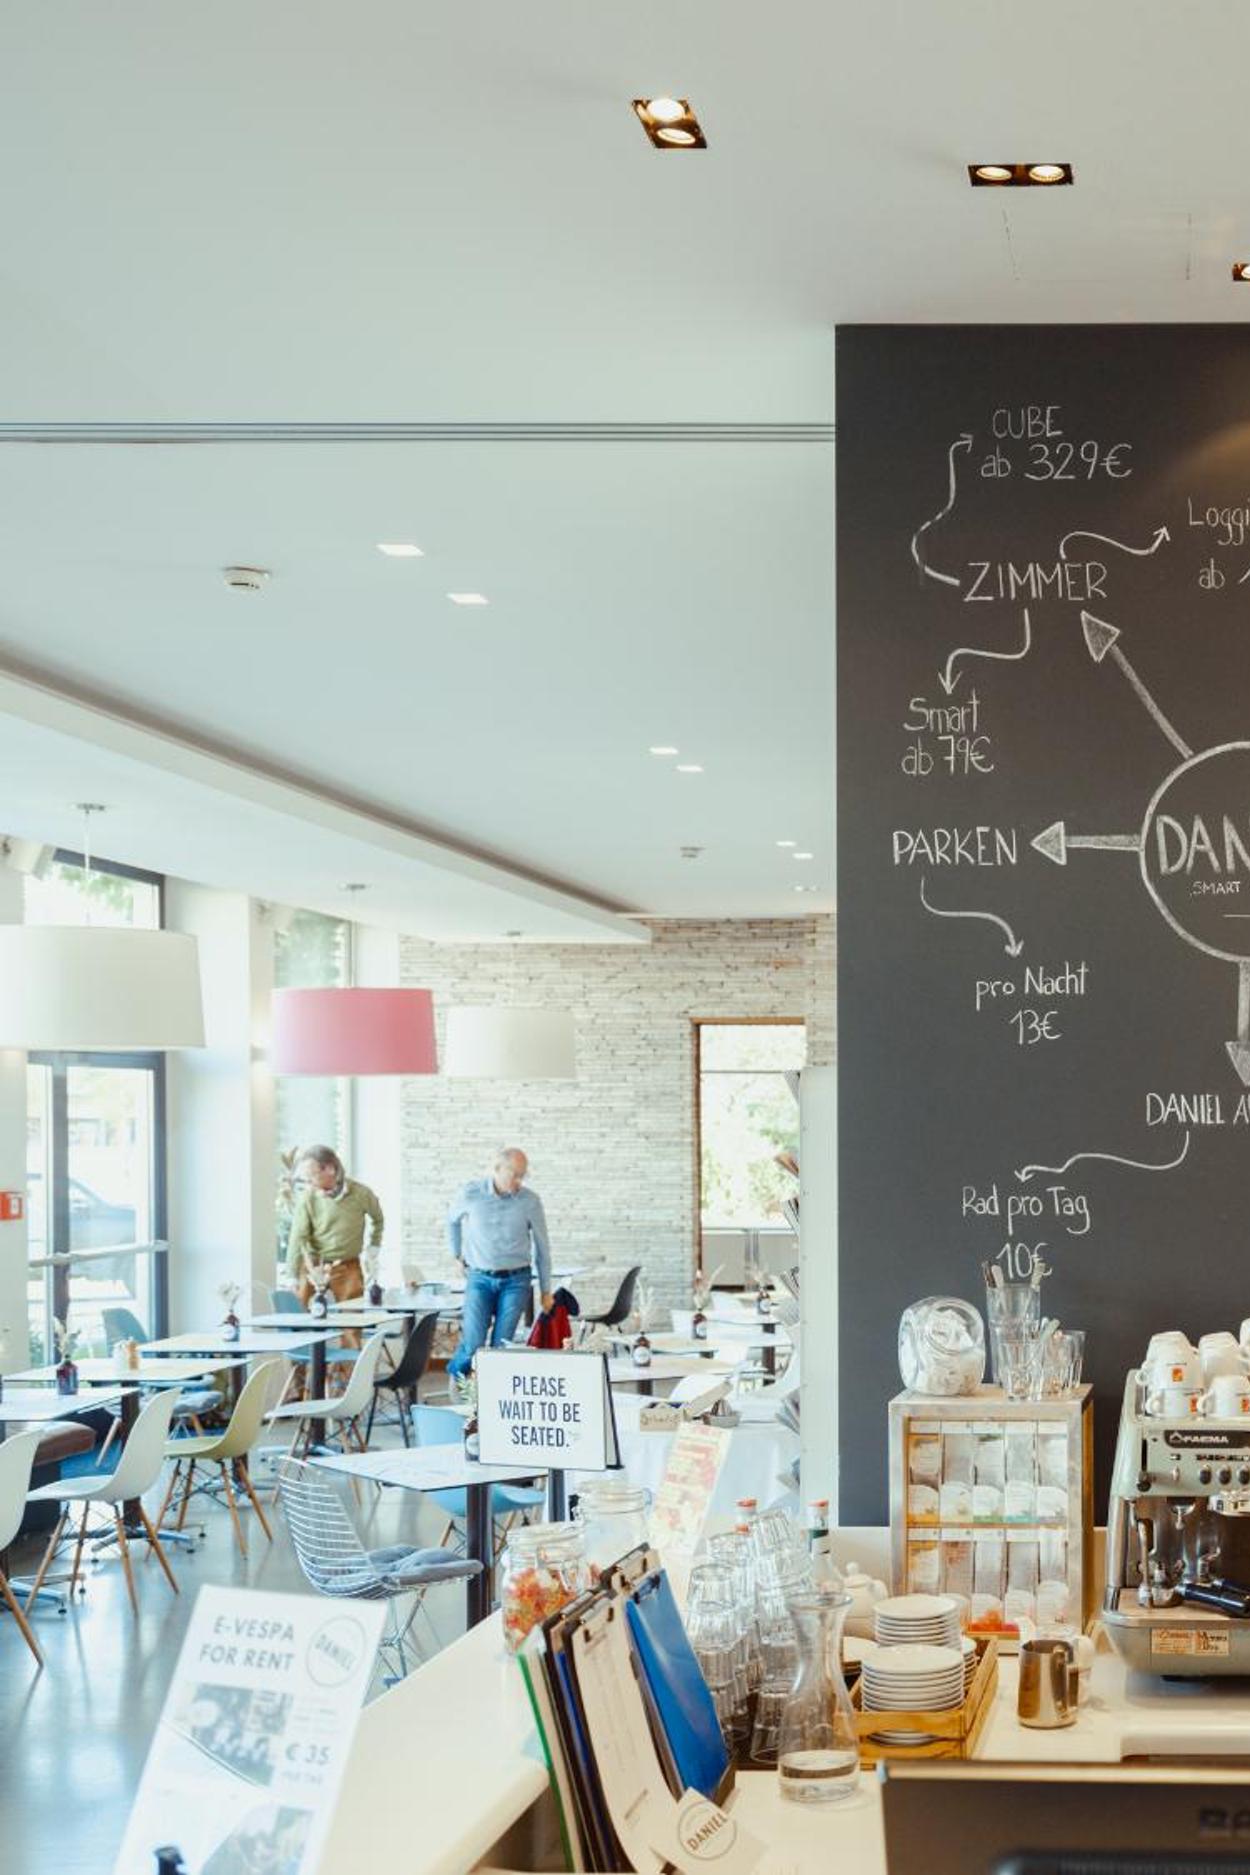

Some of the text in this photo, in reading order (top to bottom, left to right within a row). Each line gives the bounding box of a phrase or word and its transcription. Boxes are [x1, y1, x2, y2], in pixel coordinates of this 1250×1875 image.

[992, 405, 1063, 440] CUBE
[980, 442, 1133, 481] ab 329€
[963, 562, 1108, 601] ZIMMER
[1199, 555, 1225, 590] ab
[903, 688, 981, 734] Smart
[901, 736, 934, 776] ab
[892, 826, 1018, 866] PARKEN
[975, 960, 1089, 1012] pro Nacht
[1009, 1009, 1063, 1045] 13€
[1146, 1092, 1226, 1126] DANIEL
[962, 1184, 1091, 1237] Rad pro Tag
[511, 1375, 567, 1398] PLEASE
[498, 1400, 581, 1423] WAIT TO BE
[511, 1426, 570, 1448] SEATED.
[213, 1615, 294, 1642] E-VESPA
[199, 1643, 294, 1672] FOR RENT
[305, 1745, 330, 1766] 35
[687, 1812, 728, 1851] DANIEL
